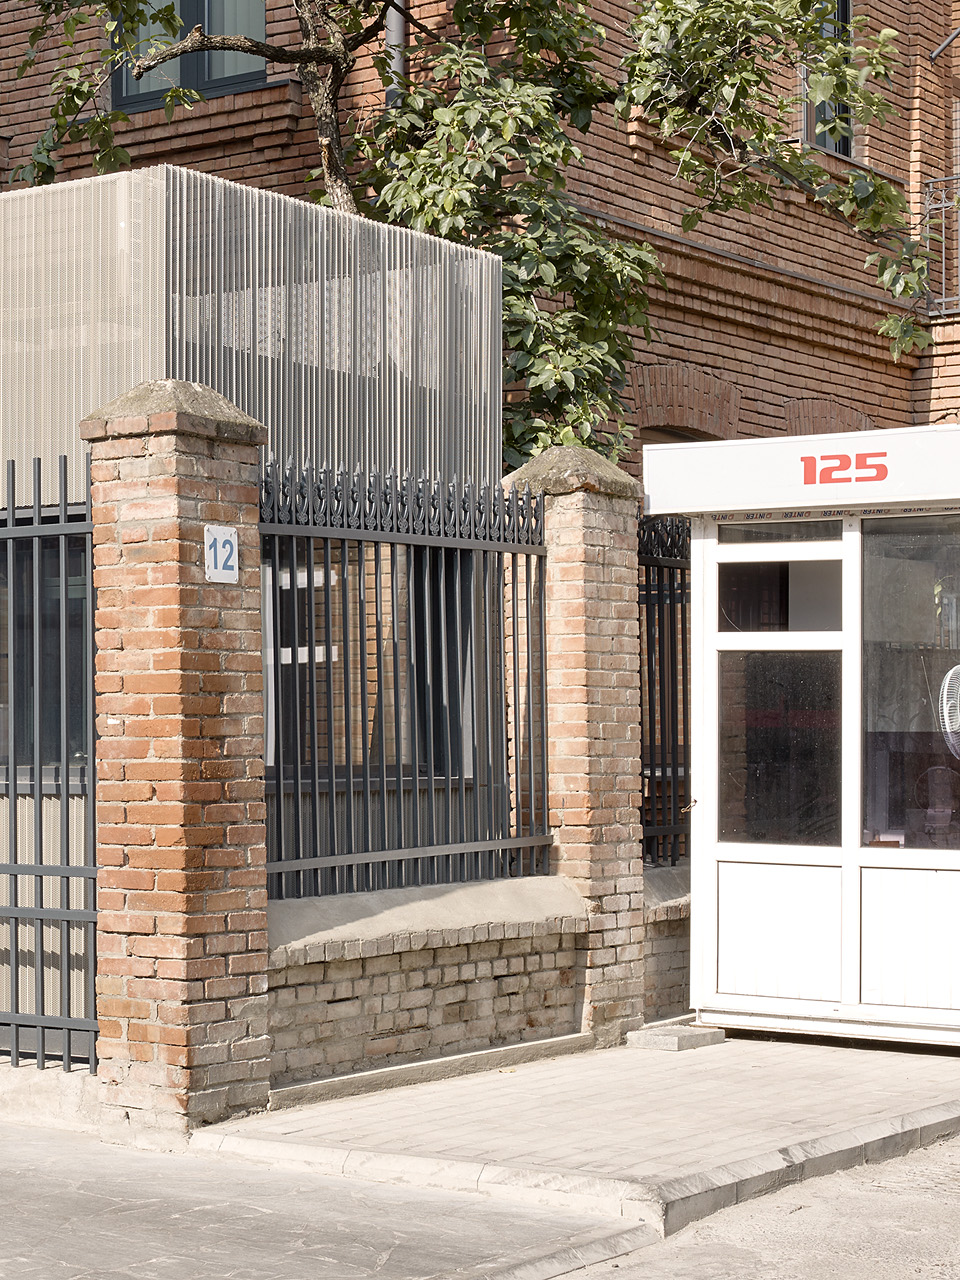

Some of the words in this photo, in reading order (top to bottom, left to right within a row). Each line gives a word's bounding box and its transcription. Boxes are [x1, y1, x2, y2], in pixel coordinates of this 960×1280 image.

[800, 452, 888, 485] 125
[711, 513, 728, 521] INTE
[745, 512, 766, 520] INTER
[784, 511, 804, 519] INTER
[208, 537, 235, 572] 12
